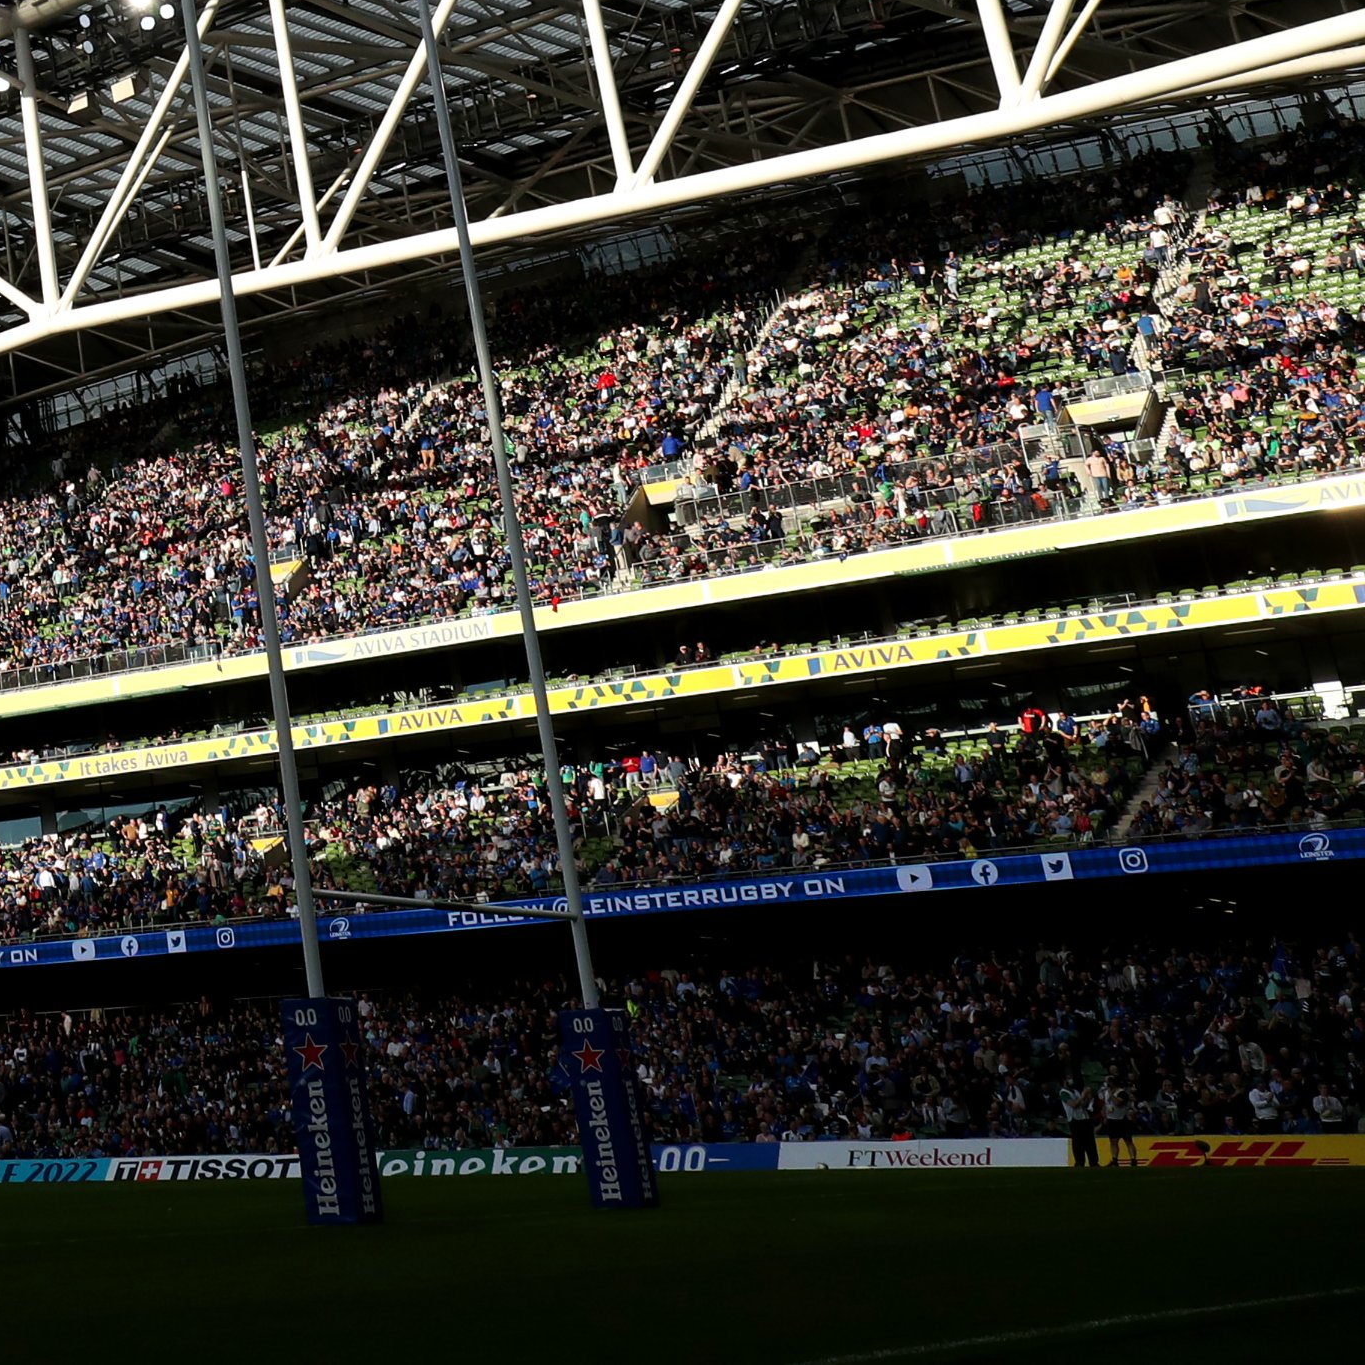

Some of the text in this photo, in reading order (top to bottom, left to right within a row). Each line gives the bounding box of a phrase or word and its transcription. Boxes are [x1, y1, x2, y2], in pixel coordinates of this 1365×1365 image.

[1320, 481, 1365, 504] AVI
[353, 622, 489, 656] AVIVA STADIUM
[834, 645, 914, 670] AVIVA
[399, 708, 463, 730] AVIVA
[80, 749, 188, 776] It takes Aviva
[552, 881, 794, 915] @EINSTERRUGBY
[803, 877, 845, 897] ON
[10, 948, 38, 964] ON
[295, 1008, 318, 1027] 0.0
[572, 1017, 595, 1034] 0.0
[308, 1079, 341, 1216] Heineken
[349, 1077, 375, 1214] Heineken
[586, 1079, 623, 1202] Heineken
[1147, 1141, 1317, 1167] DHL
[26, 1162, 98, 1184] 2022
[166, 1158, 300, 1180] TISSOT
